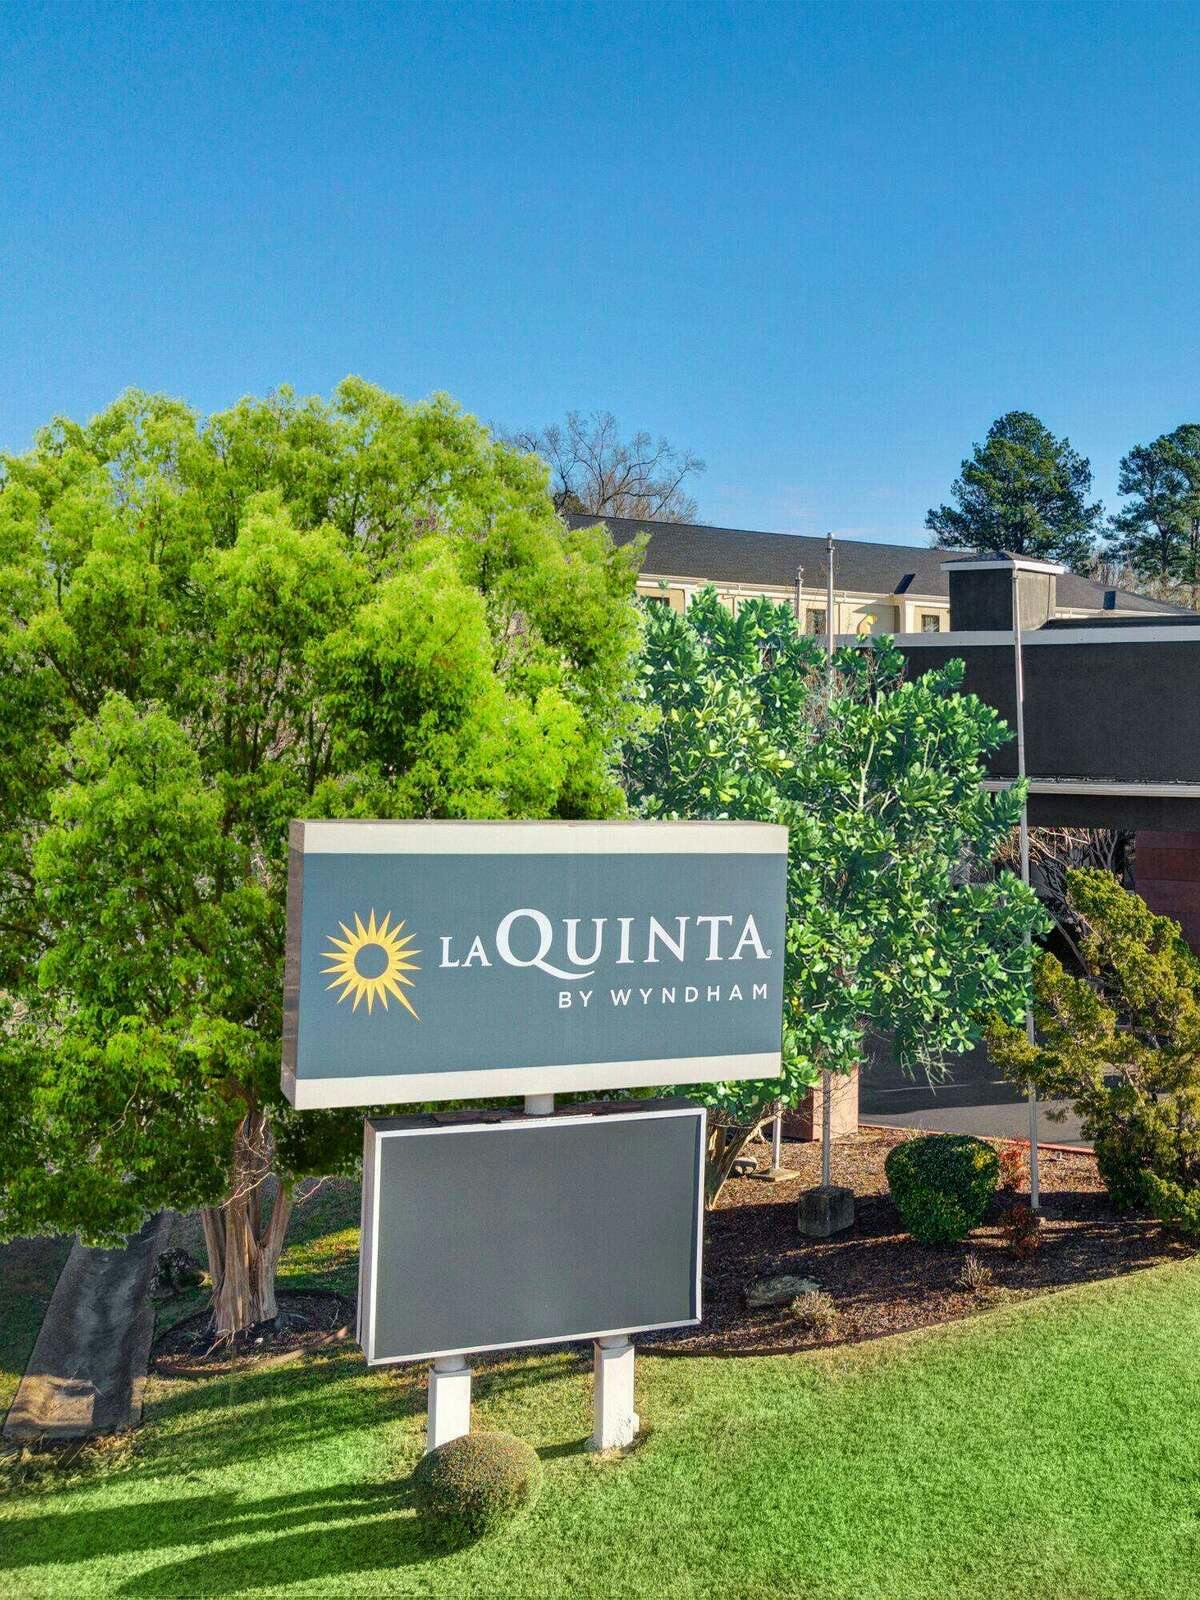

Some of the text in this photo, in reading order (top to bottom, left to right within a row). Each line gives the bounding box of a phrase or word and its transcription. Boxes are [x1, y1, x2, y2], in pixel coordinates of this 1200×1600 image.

[439, 908, 769, 980] LA QUINTA
[558, 983, 769, 1009] BY WYNDHAM
